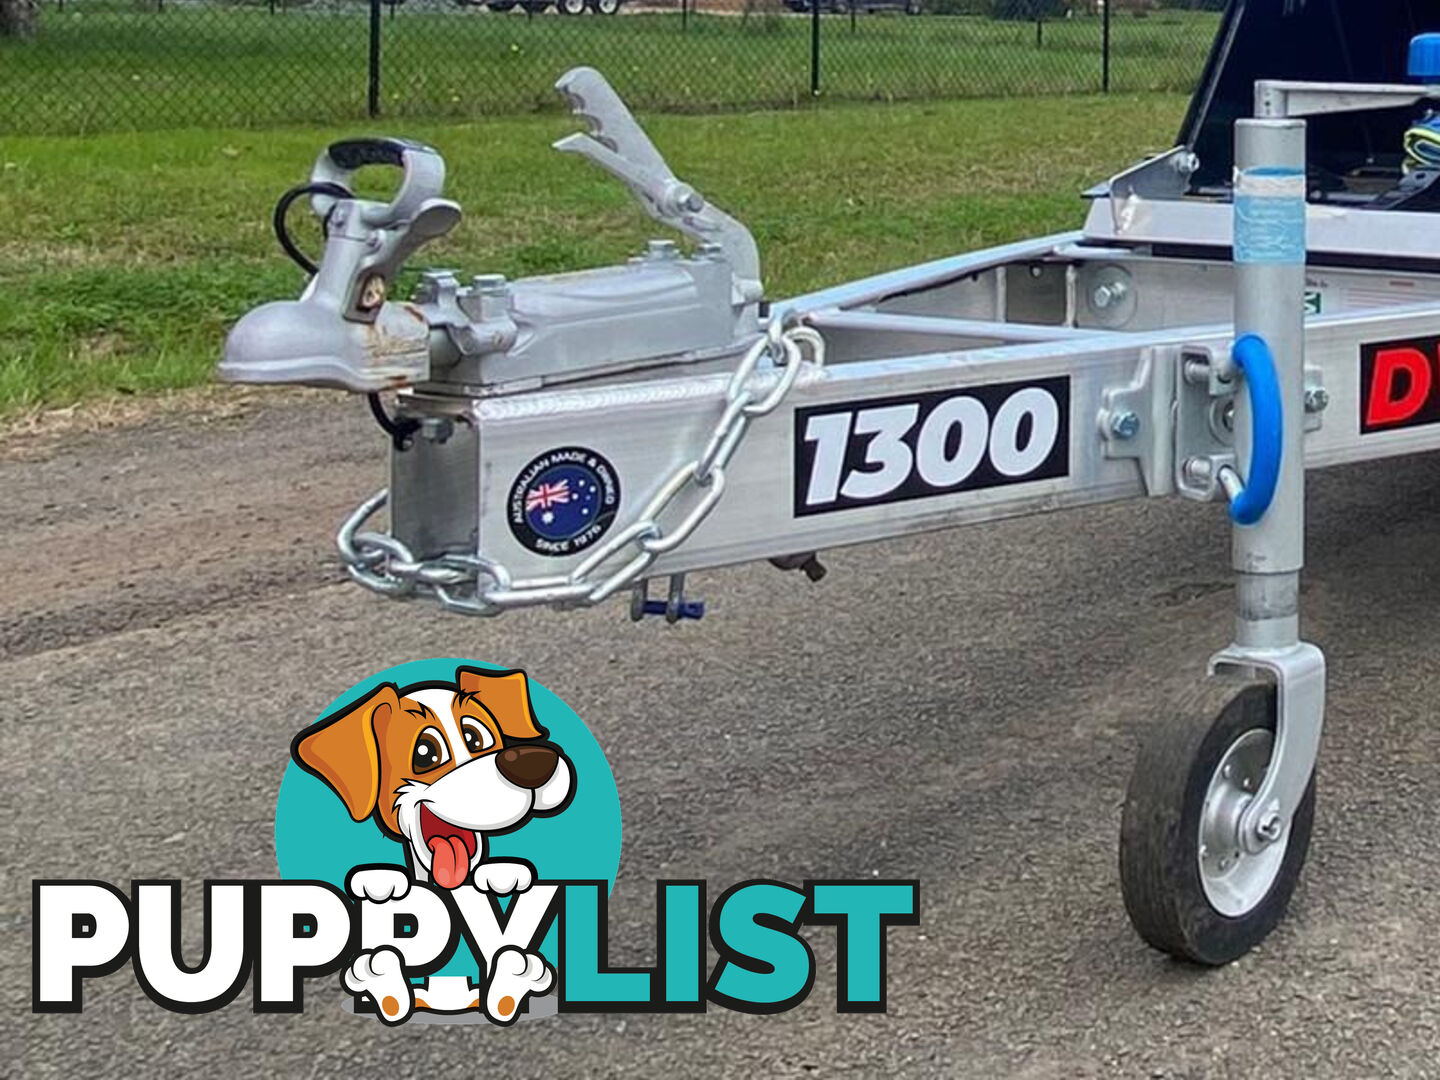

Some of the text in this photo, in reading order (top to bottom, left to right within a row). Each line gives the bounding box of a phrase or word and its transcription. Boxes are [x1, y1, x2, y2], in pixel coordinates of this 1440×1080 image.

[804, 387, 1059, 505] 1300
[512, 460, 550, 523] AUSTRALIAN
[550, 451, 588, 463] MADE
[587, 458, 598, 468] &
[535, 538, 569, 552] SINCE
